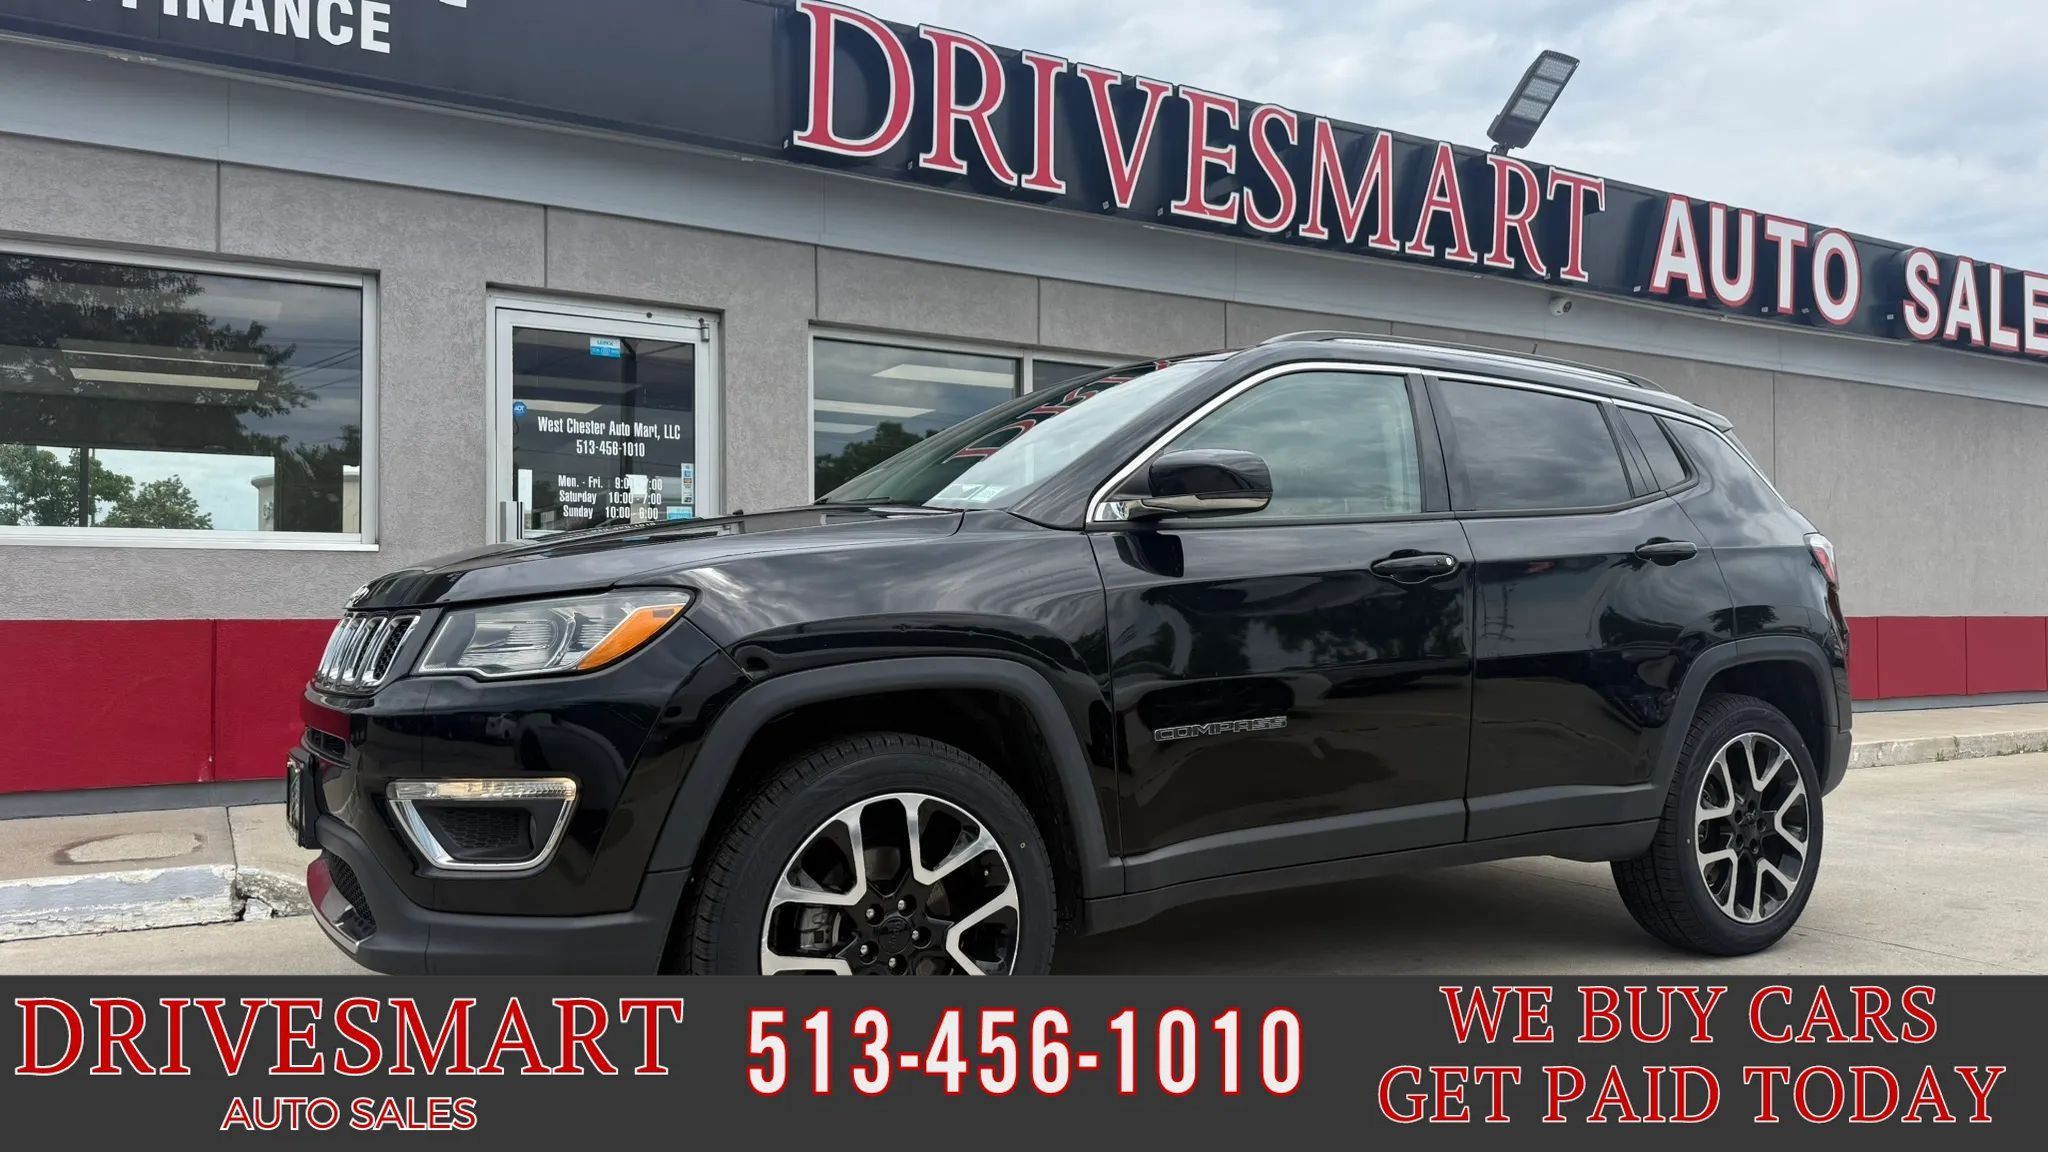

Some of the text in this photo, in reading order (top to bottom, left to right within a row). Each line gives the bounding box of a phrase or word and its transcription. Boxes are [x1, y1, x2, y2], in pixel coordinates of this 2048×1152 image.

[121, 0, 391, 53] ANCE
[793, 0, 1606, 283] DRIVESMART
[1649, 194, 1861, 325] AUTO
[537, 416, 681, 440] West Chester Auto Mart, LLC
[558, 475, 580, 488] Mon.
[588, 476, 604, 489] Fri.
[559, 490, 597, 505] Saturday
[608, 491, 634, 504] 10:00
[642, 492, 662, 505] 7:00
[562, 505, 594, 519] Sunday
[605, 506, 631, 519] 10:00
[1154, 716, 1287, 741] COMPASS
